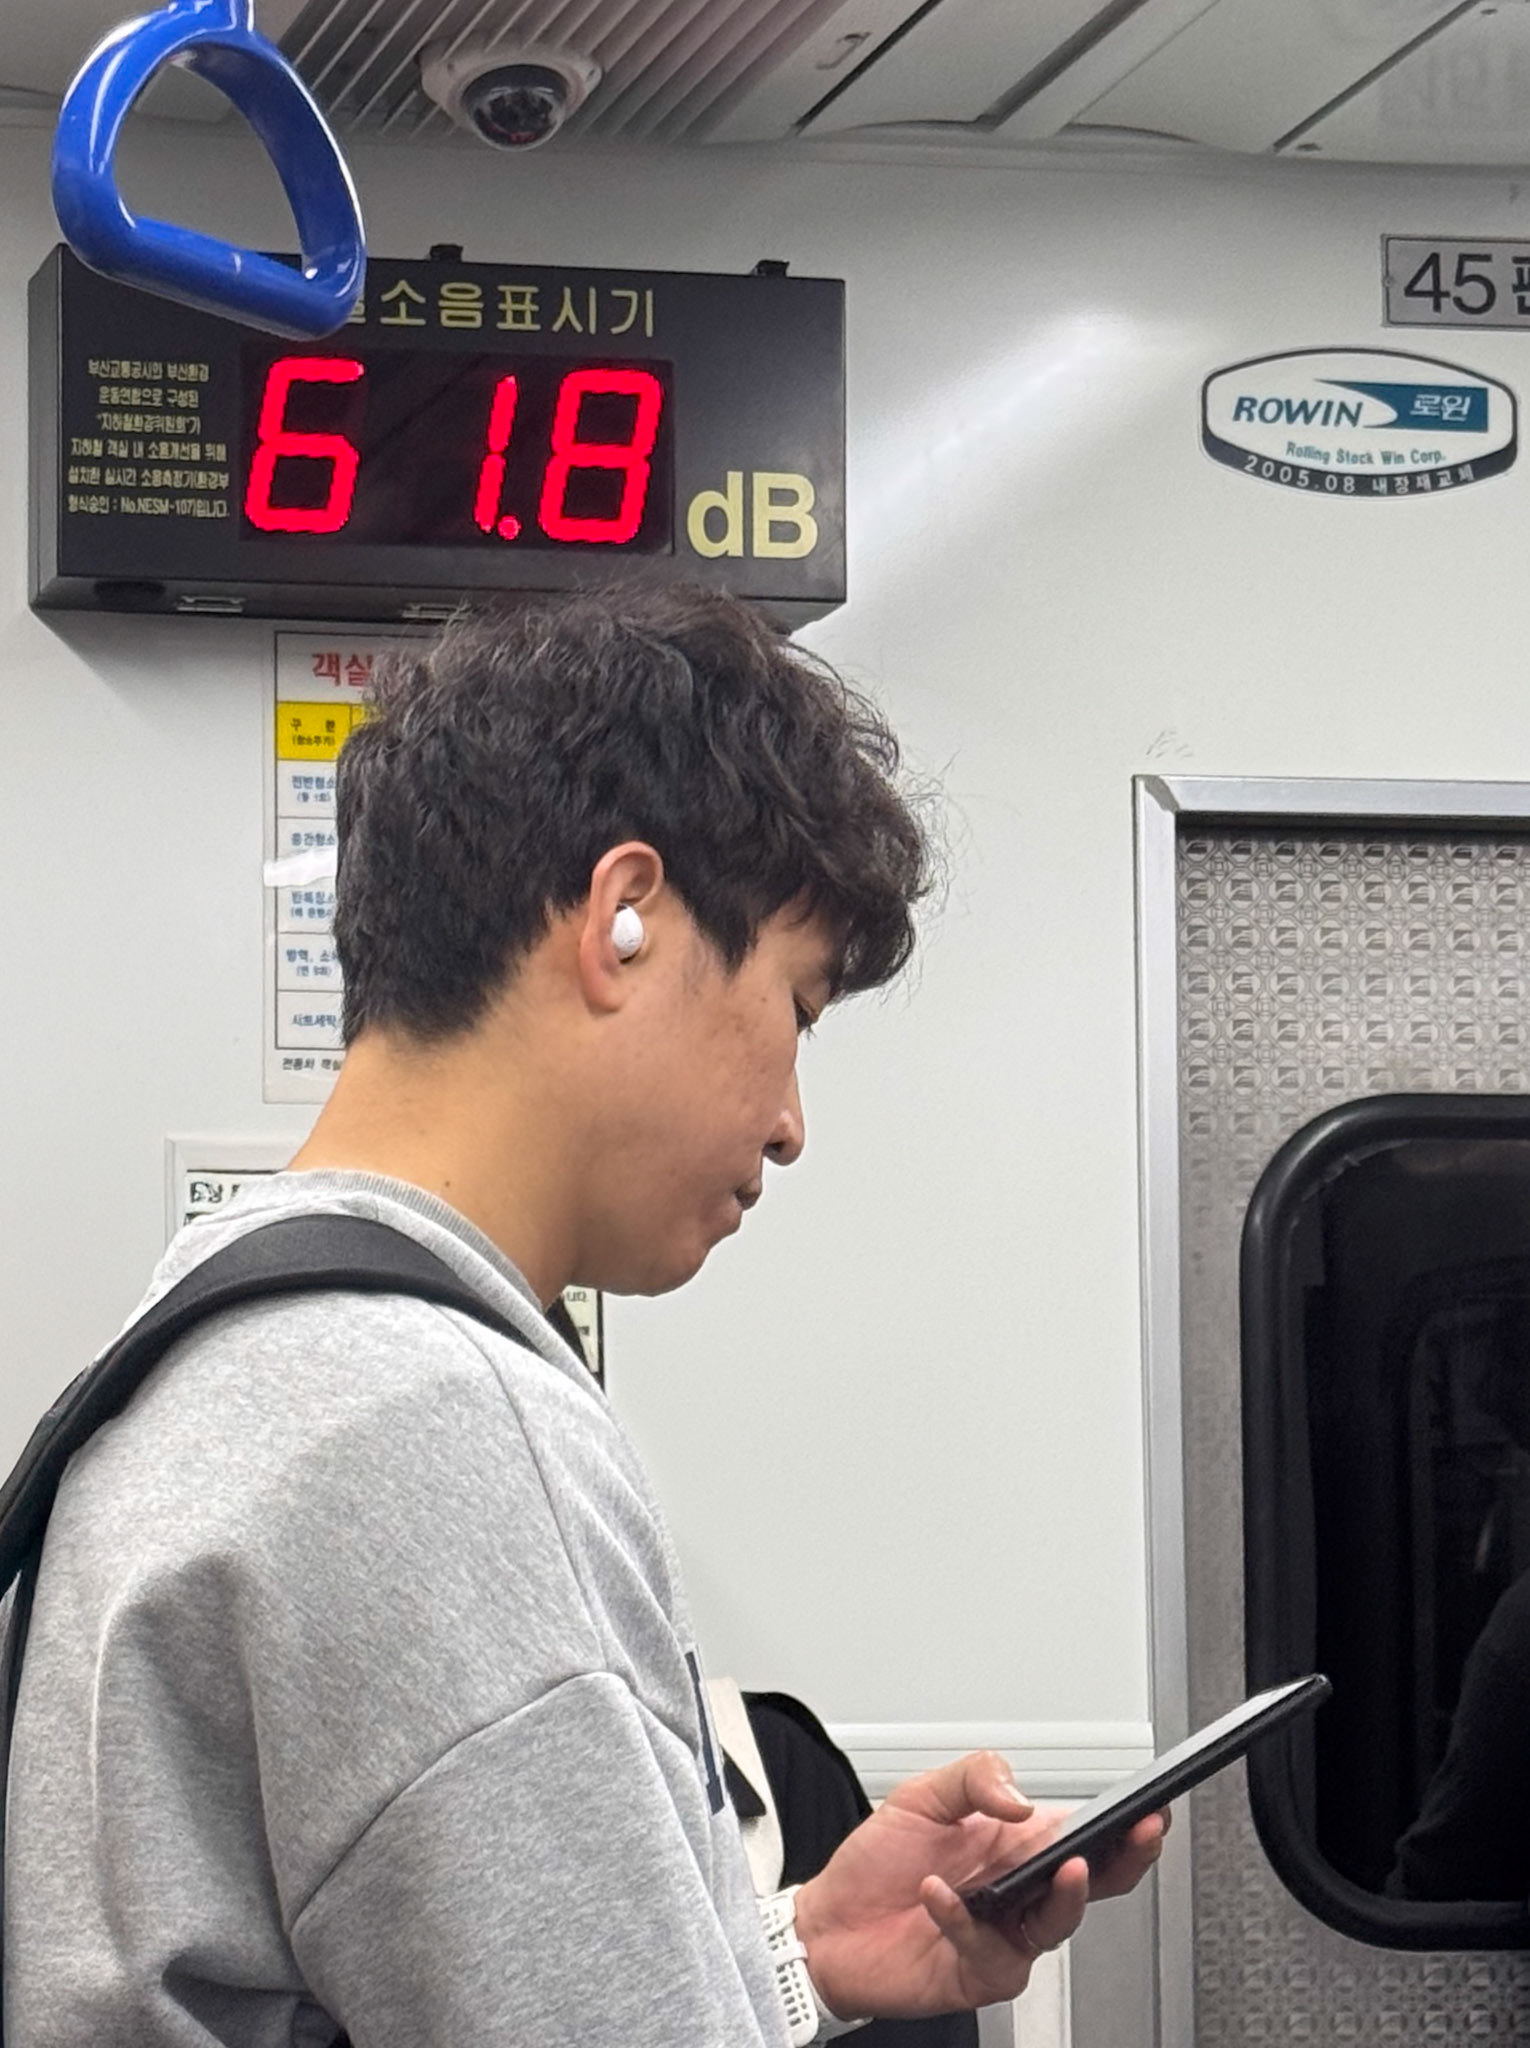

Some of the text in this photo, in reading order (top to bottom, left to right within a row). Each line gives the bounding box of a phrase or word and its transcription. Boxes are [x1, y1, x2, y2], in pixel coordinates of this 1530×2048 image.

[1404, 252, 1496, 315] 45
[167, 362, 209, 383] 부산환경
[98, 385, 199, 409] 운동연합으로 구성된
[1409, 393, 1472, 422] 로윈
[1232, 396, 1363, 428] ROWIN
[70, 438, 227, 462] 지하철 객실 내 소음개선을 위해
[1286, 440, 1446, 466] Rolling Stock Win Corp.
[68, 465, 101, 485] 설치한
[104, 466, 137, 487] 실시간
[1243, 454, 1475, 495] 2005.08 내장재교체
[67, 493, 110, 514] 형식승인
[686, 470, 819, 560] dB
